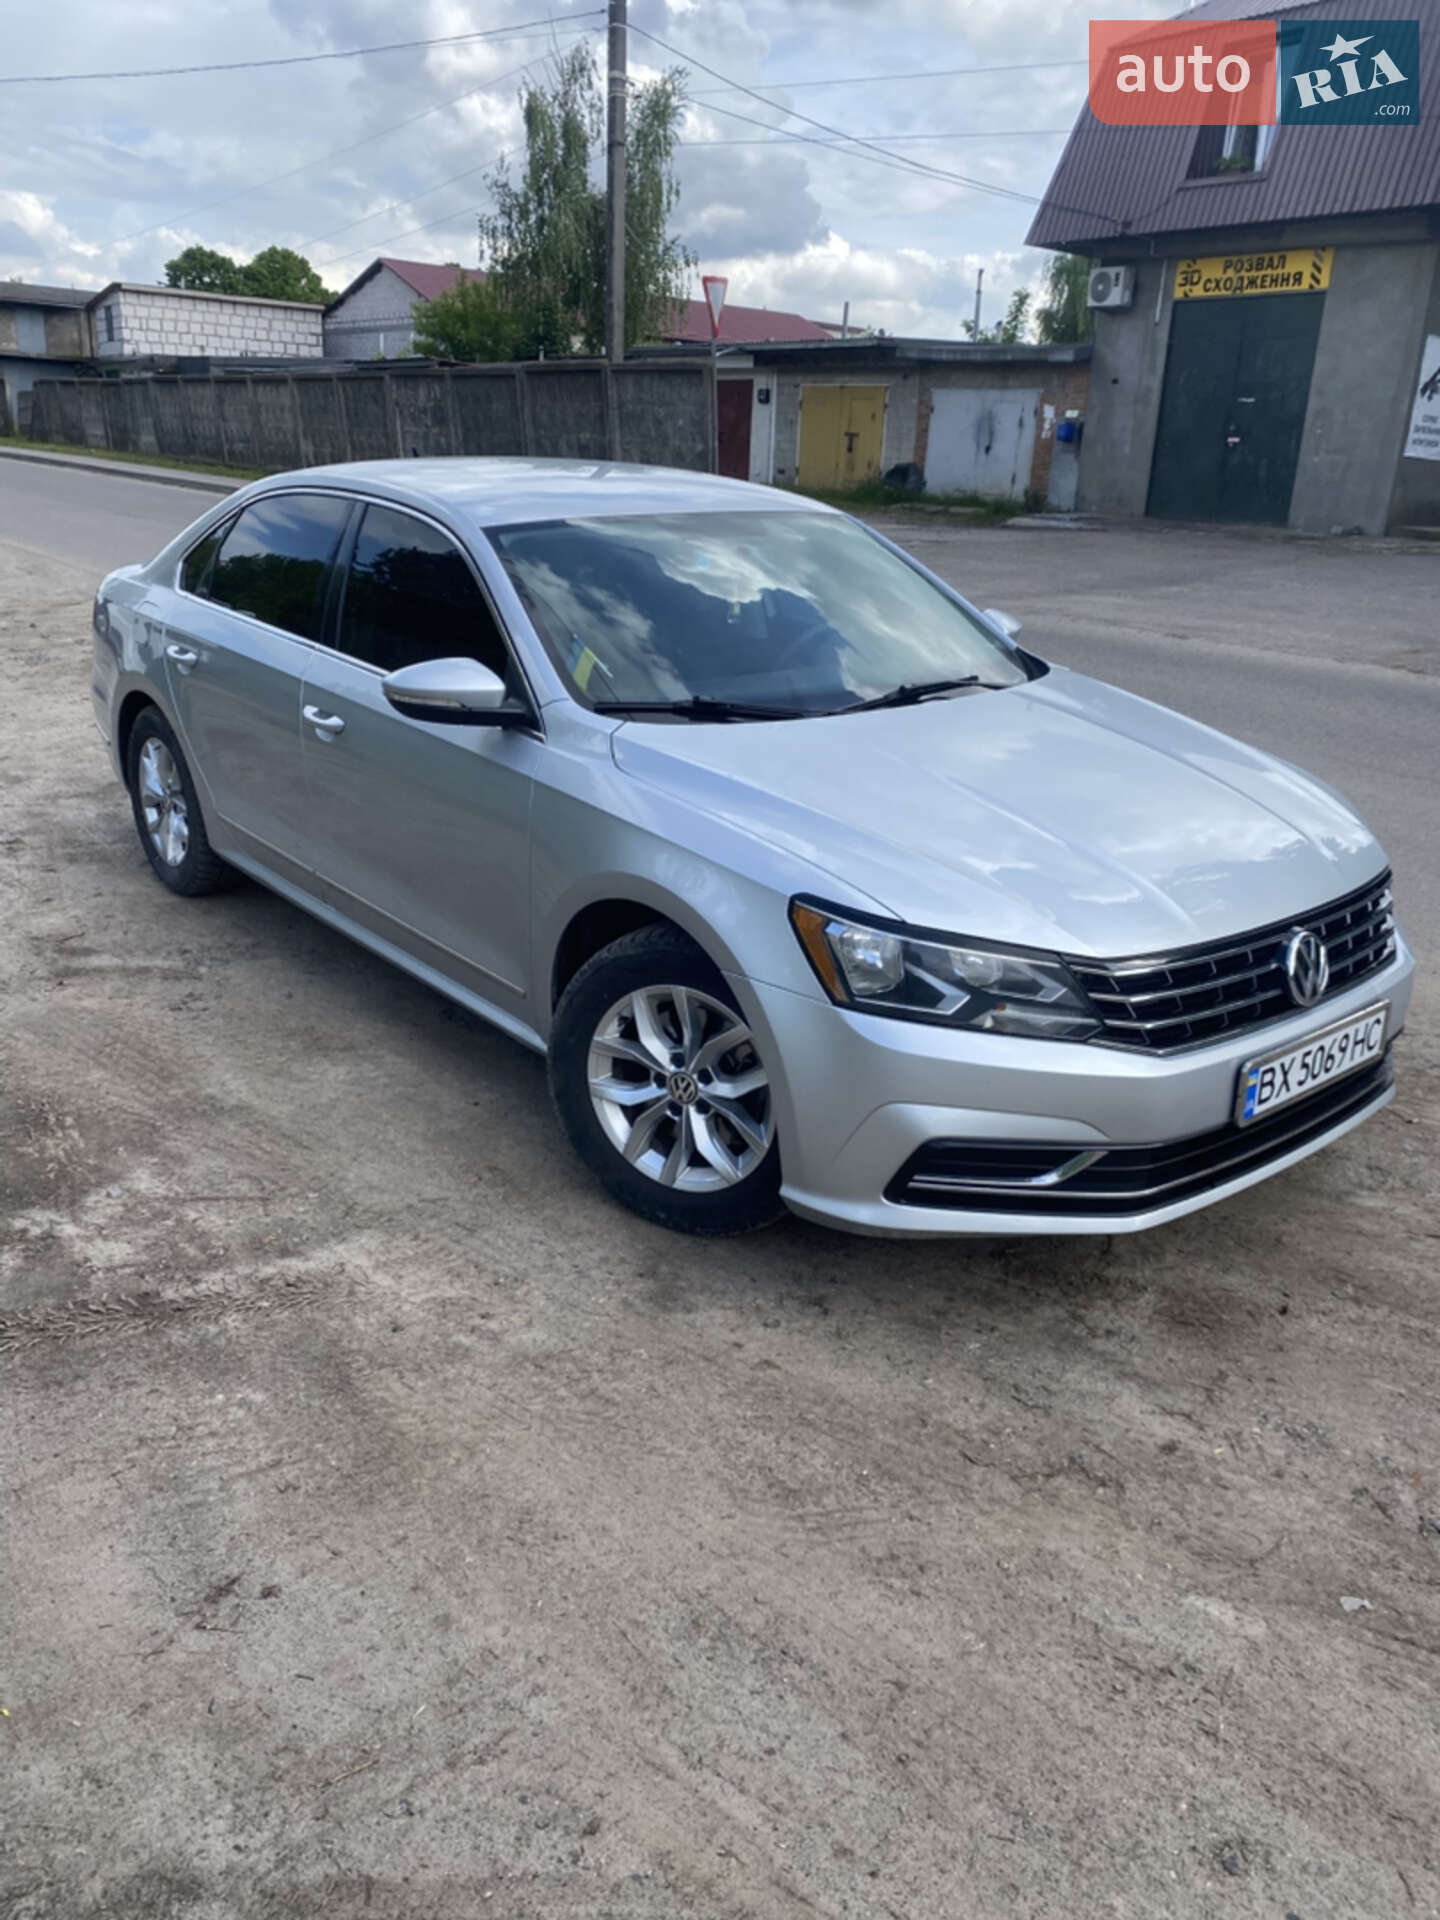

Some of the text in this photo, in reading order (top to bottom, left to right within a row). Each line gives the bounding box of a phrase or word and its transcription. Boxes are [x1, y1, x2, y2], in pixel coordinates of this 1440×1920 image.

[1222, 254, 1287, 274] РОЗВАЛ
[1178, 269, 1202, 287] 3D
[1203, 271, 1303, 293] СХОДЖЕННЯ
[1297, 1033, 1350, 1087] 5069
